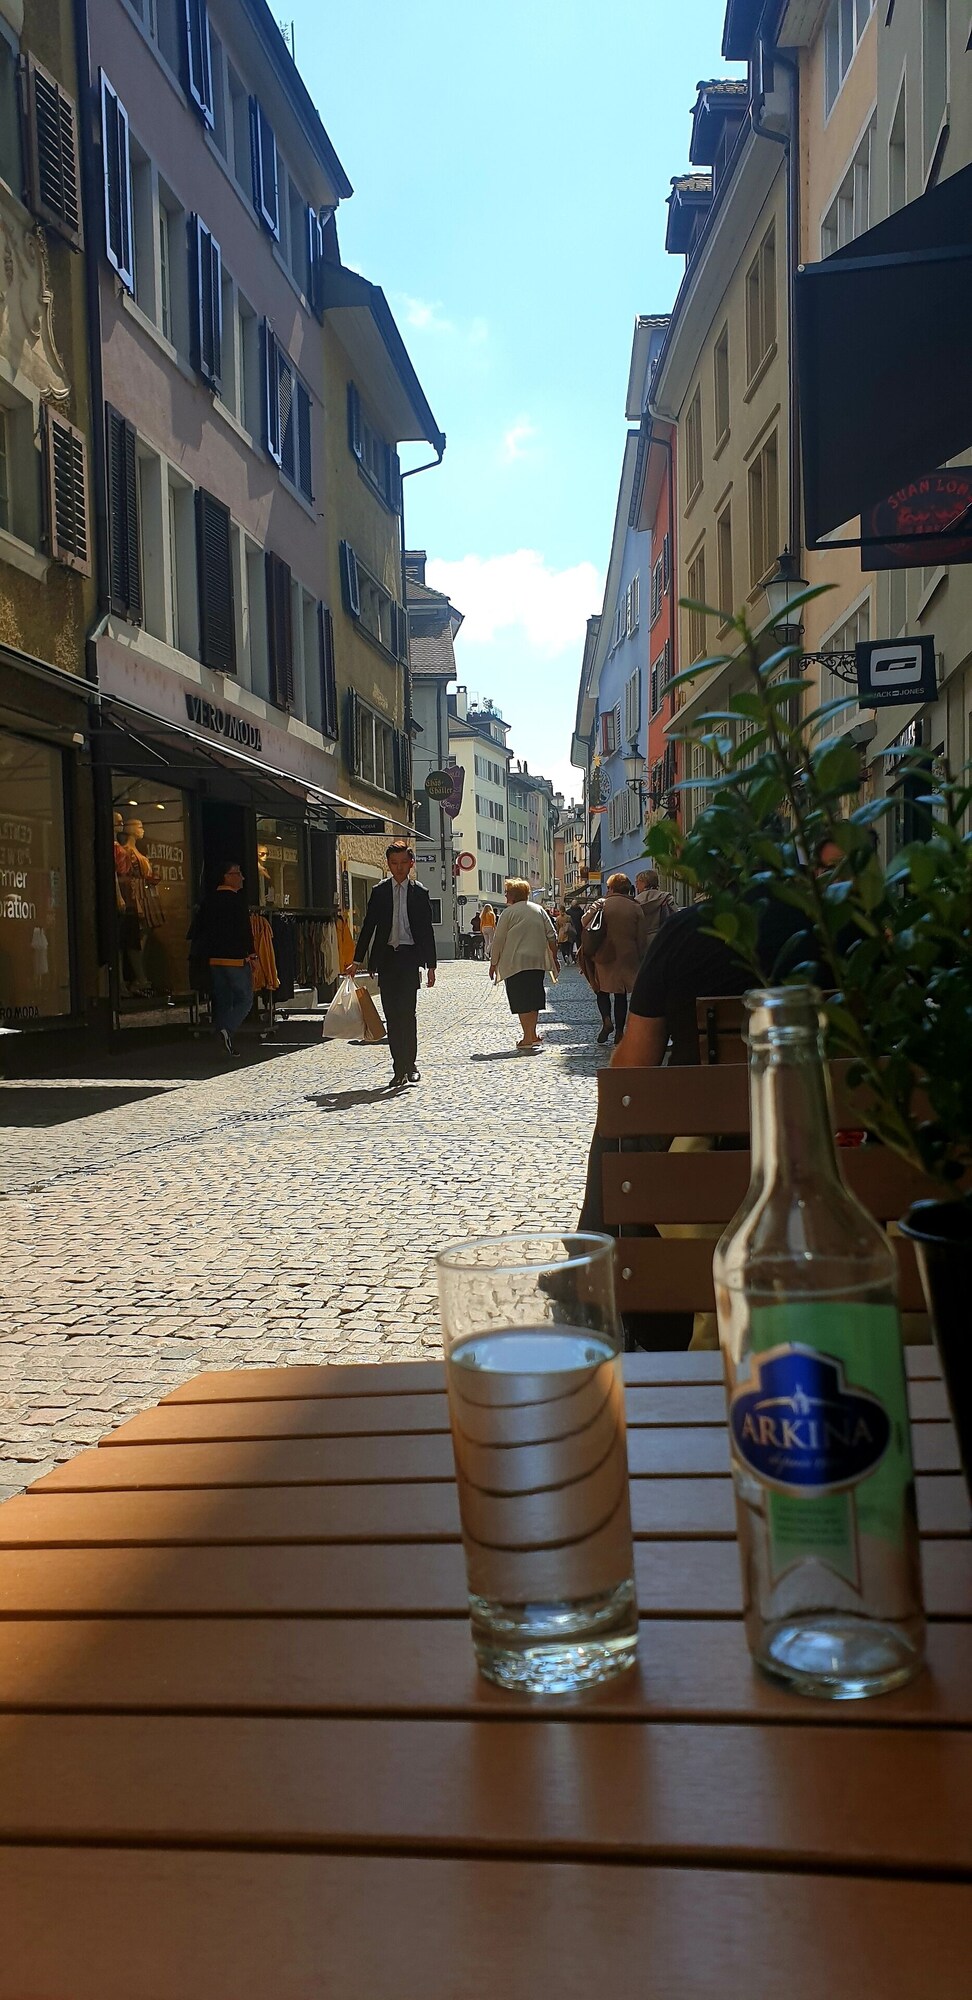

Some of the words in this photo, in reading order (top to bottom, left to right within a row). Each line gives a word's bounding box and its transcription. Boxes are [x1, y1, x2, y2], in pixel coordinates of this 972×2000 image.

[899, 687, 925, 696] JONES
[185, 693, 228, 736] VERO
[228, 714, 262, 752] MODA
[742, 1411, 873, 1449] ARKINA
